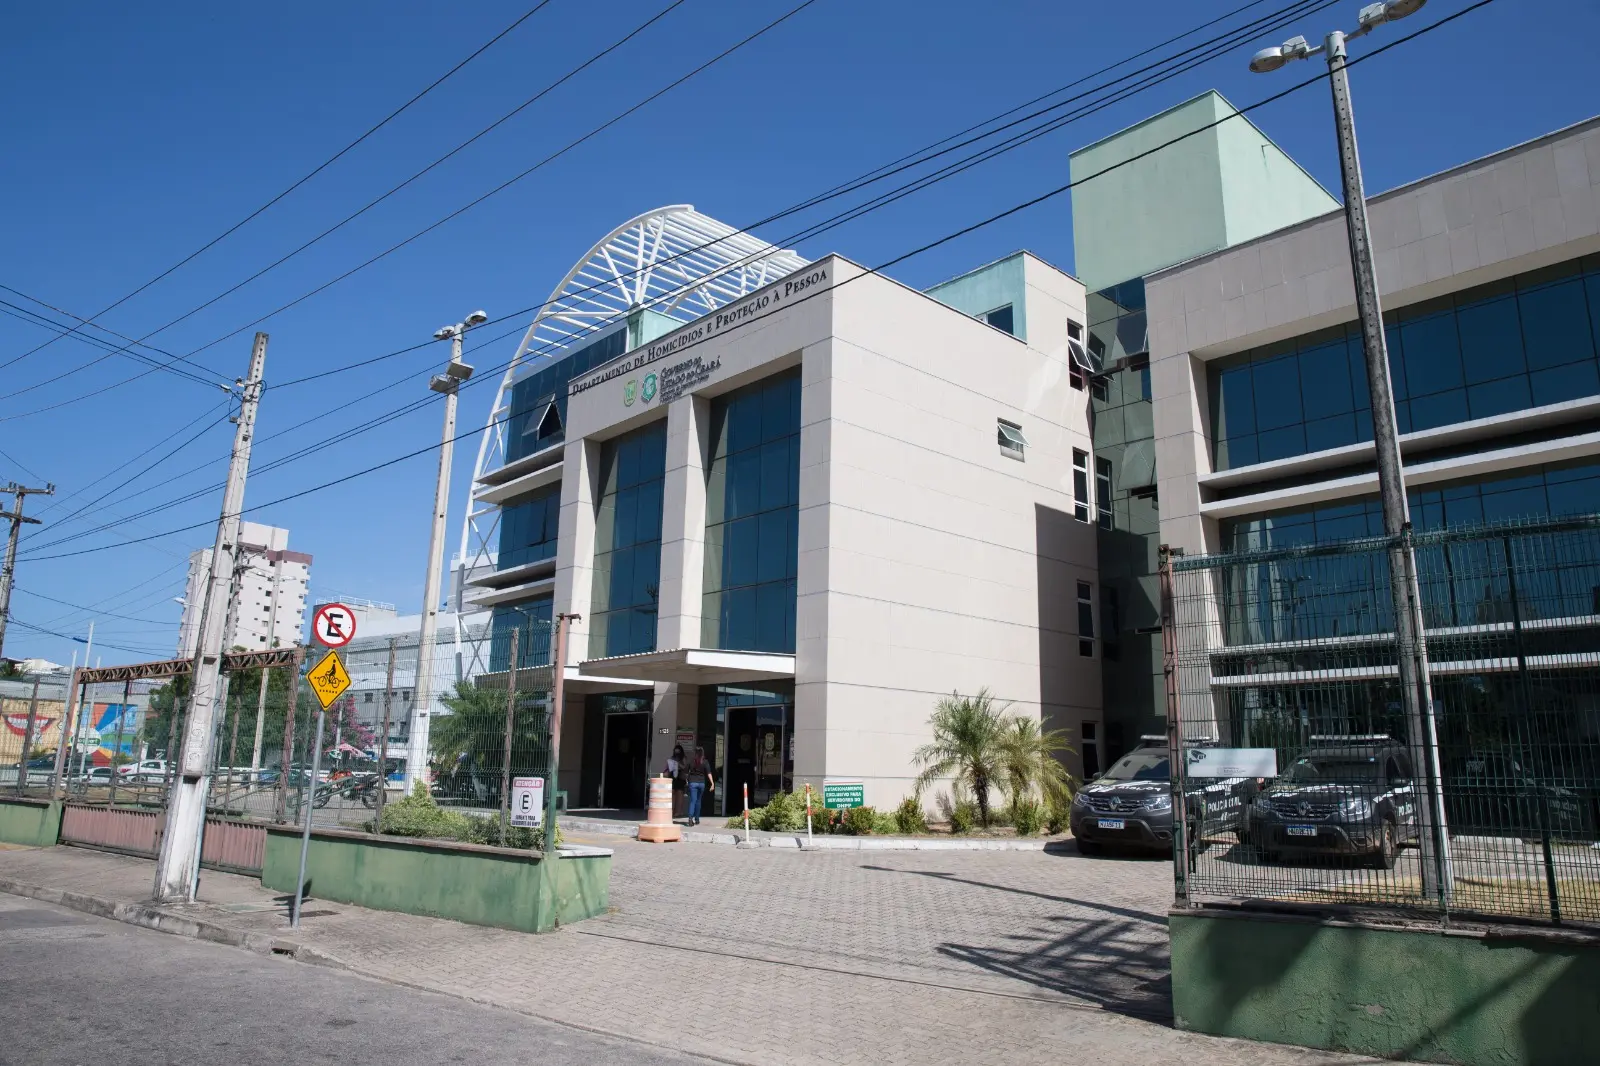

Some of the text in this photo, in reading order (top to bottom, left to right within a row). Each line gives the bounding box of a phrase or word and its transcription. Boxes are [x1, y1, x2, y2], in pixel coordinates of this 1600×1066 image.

[648, 327, 703, 361] HOMICÍDIOS
[784, 269, 828, 298] PESSOA
[327, 613, 343, 637] E
[522, 795, 529, 809] E
